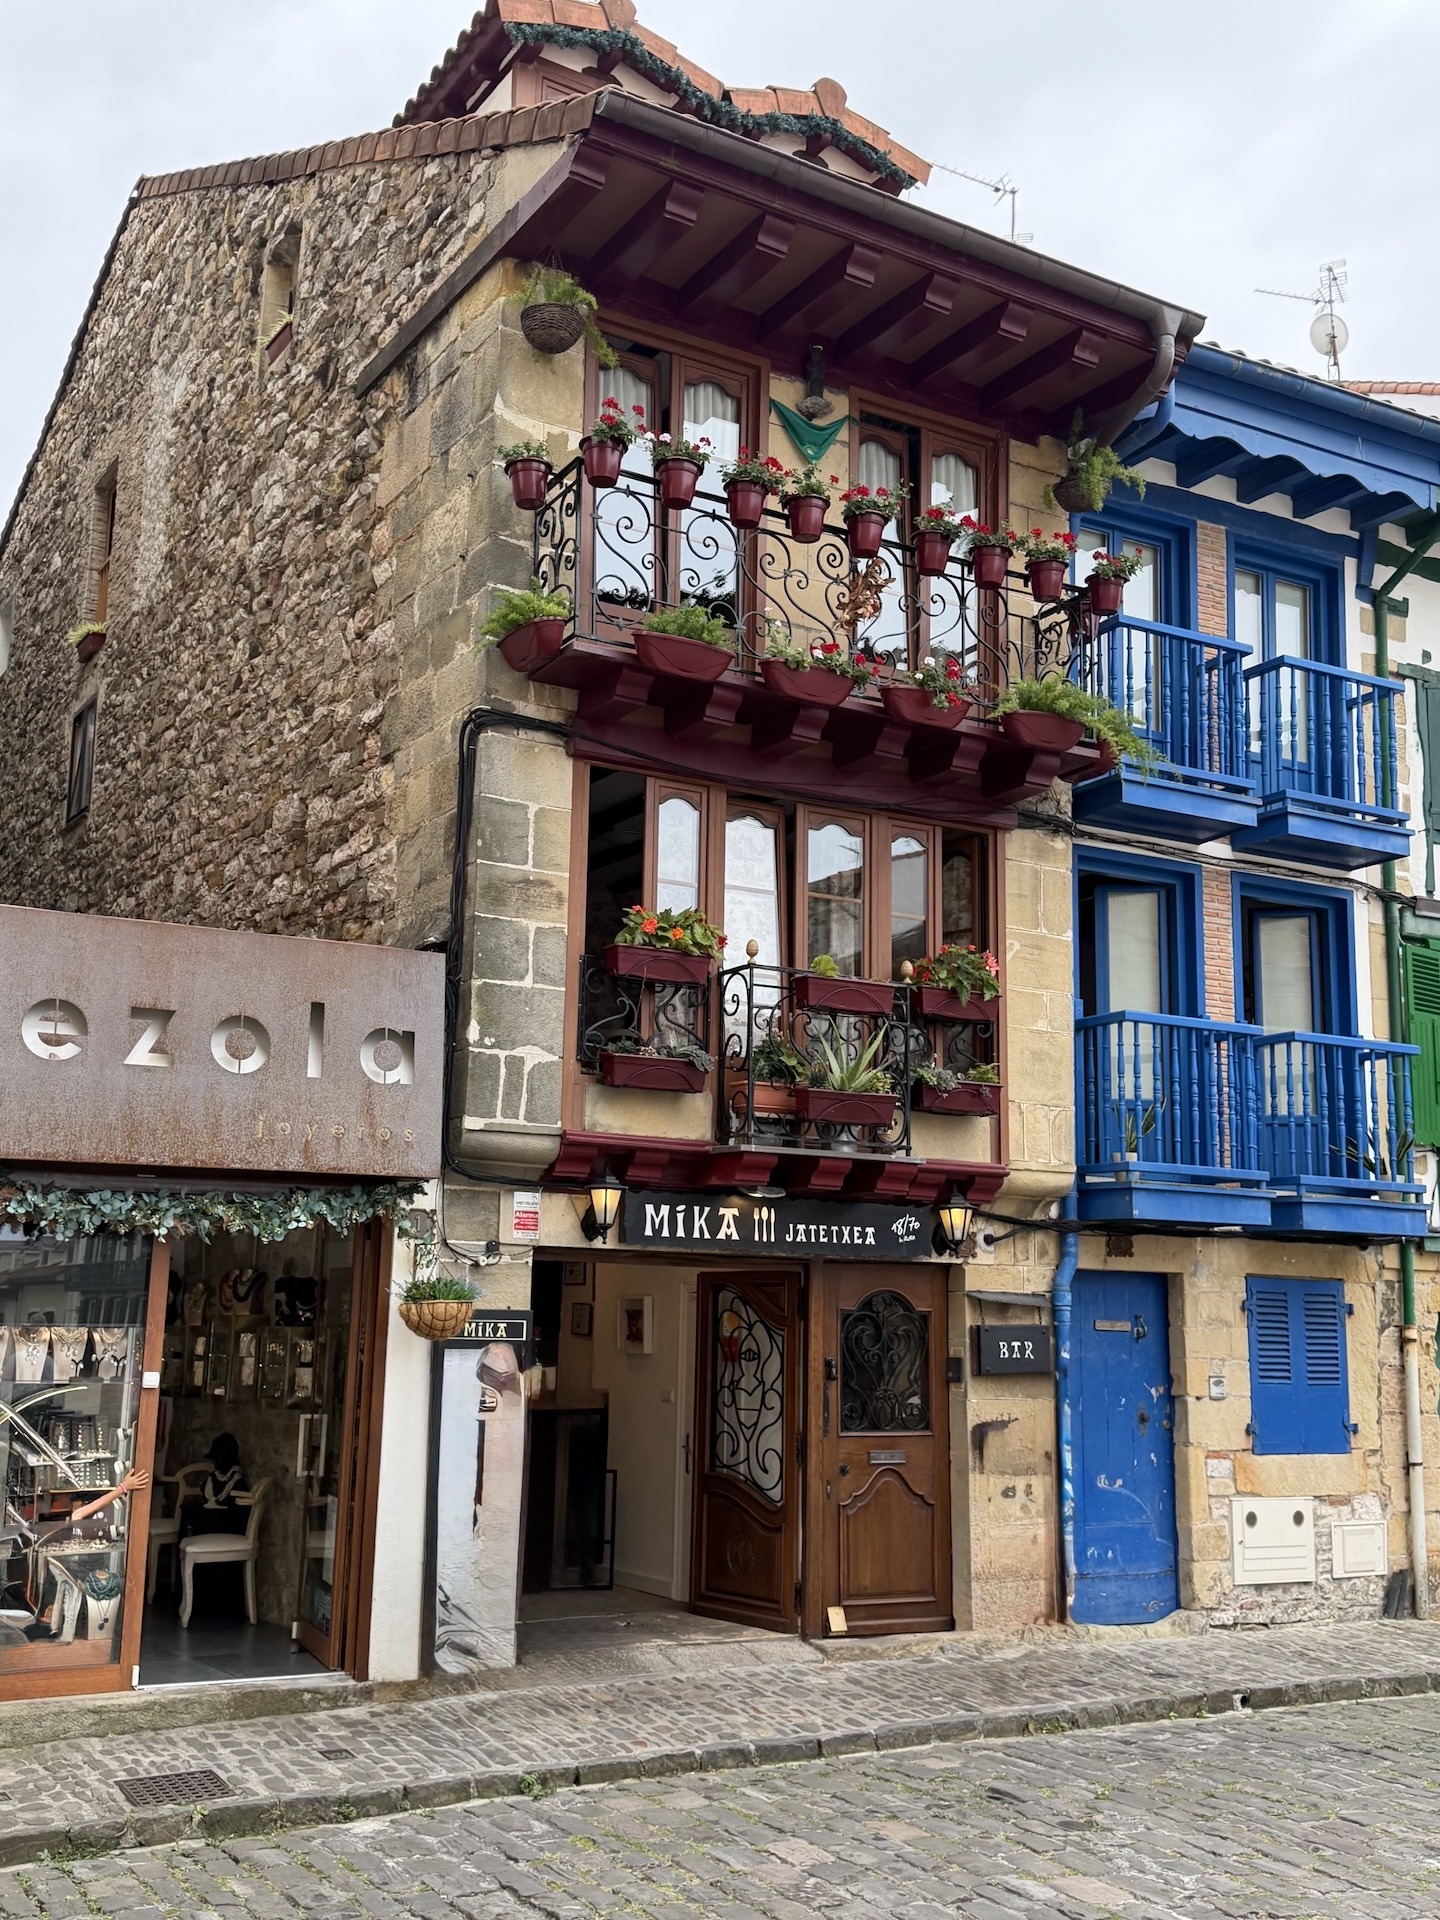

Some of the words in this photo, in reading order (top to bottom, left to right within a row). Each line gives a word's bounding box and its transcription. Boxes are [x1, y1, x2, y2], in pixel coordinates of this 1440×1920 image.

[21, 998, 416, 1085] ezola
[256, 1113, 415, 1142] joyeros
[786, 1223, 876, 1245] JATETXEA
[999, 1341, 1034, 1360] BAR
